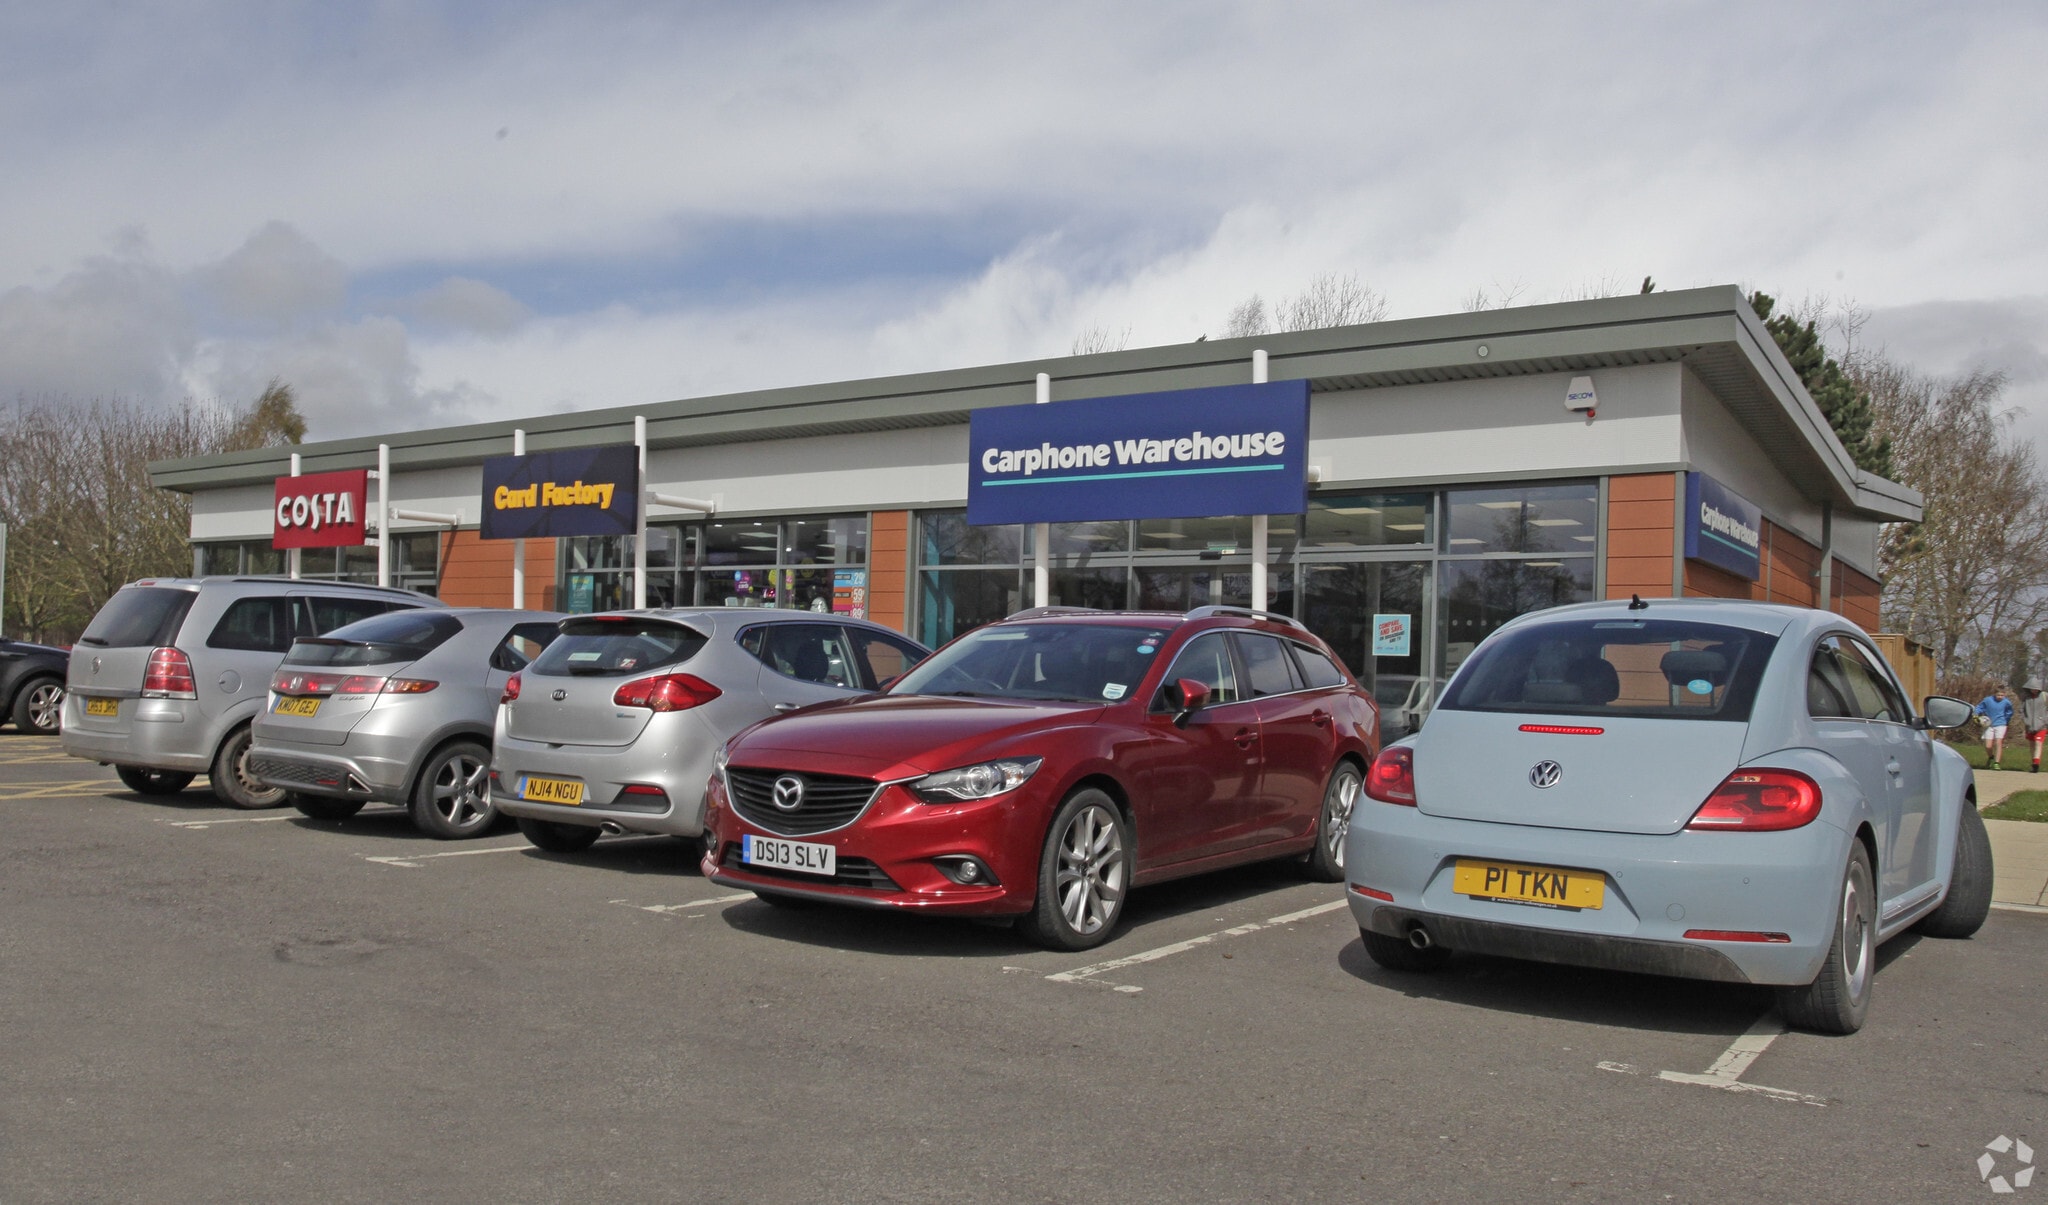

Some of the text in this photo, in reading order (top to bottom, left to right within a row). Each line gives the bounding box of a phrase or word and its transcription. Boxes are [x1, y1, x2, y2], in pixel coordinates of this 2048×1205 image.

[1568, 392, 1593, 400] SECOM
[982, 431, 1285, 476] Carphone Warehouse
[494, 480, 615, 510] Card Factory
[277, 492, 355, 530] COSTA
[1701, 501, 1759, 549] Carphone Warehouse
[277, 697, 318, 714] KM07 GEJ
[553, 691, 565, 699] KIA
[529, 780, 579, 800] NJ14 NGU
[756, 840, 828, 869] DS13 SLV
[1517, 870, 1568, 900] TKN
